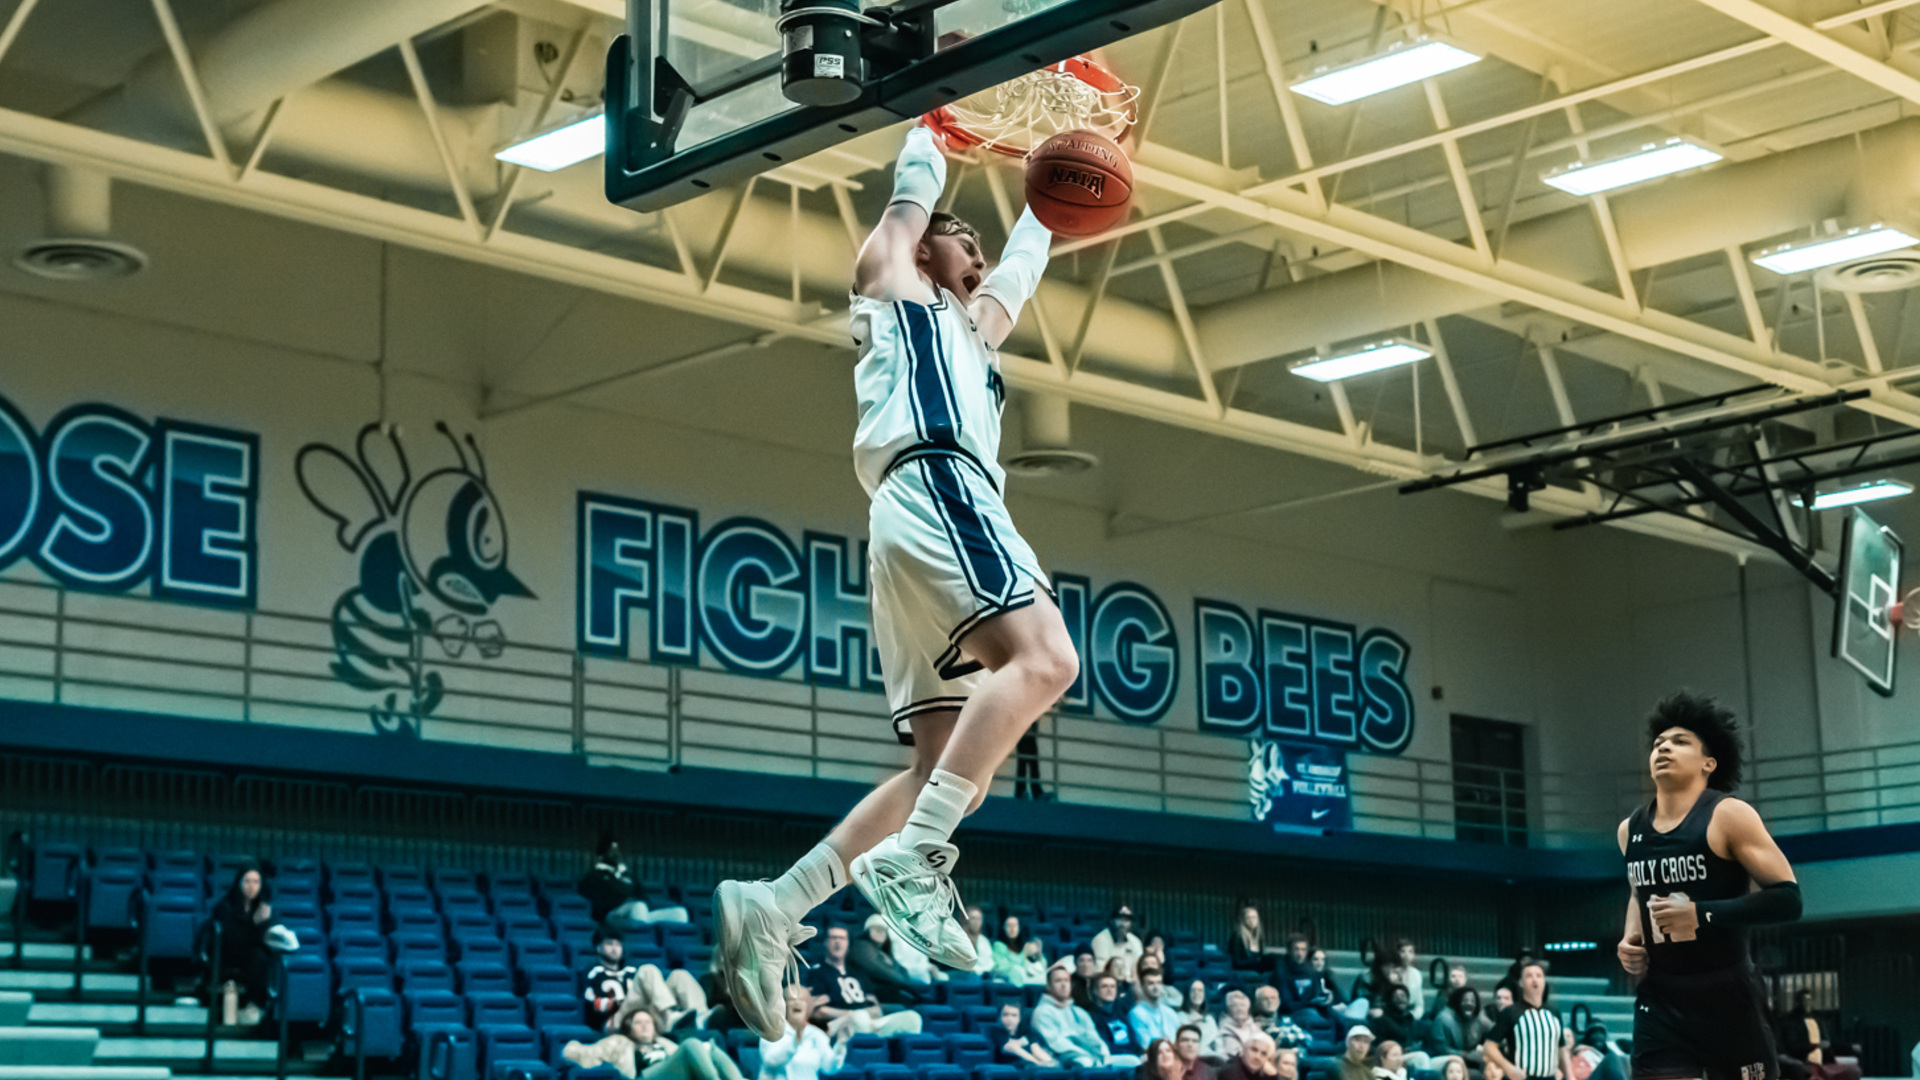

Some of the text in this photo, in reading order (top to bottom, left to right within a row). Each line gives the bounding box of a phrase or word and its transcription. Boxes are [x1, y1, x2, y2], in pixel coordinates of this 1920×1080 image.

[1046, 166, 1105, 200] NAIA
[577, 490, 1415, 756] FIGHG BEES
[1627, 854, 1707, 887] HOLY CROSS
[837, 976, 865, 1004] 18
